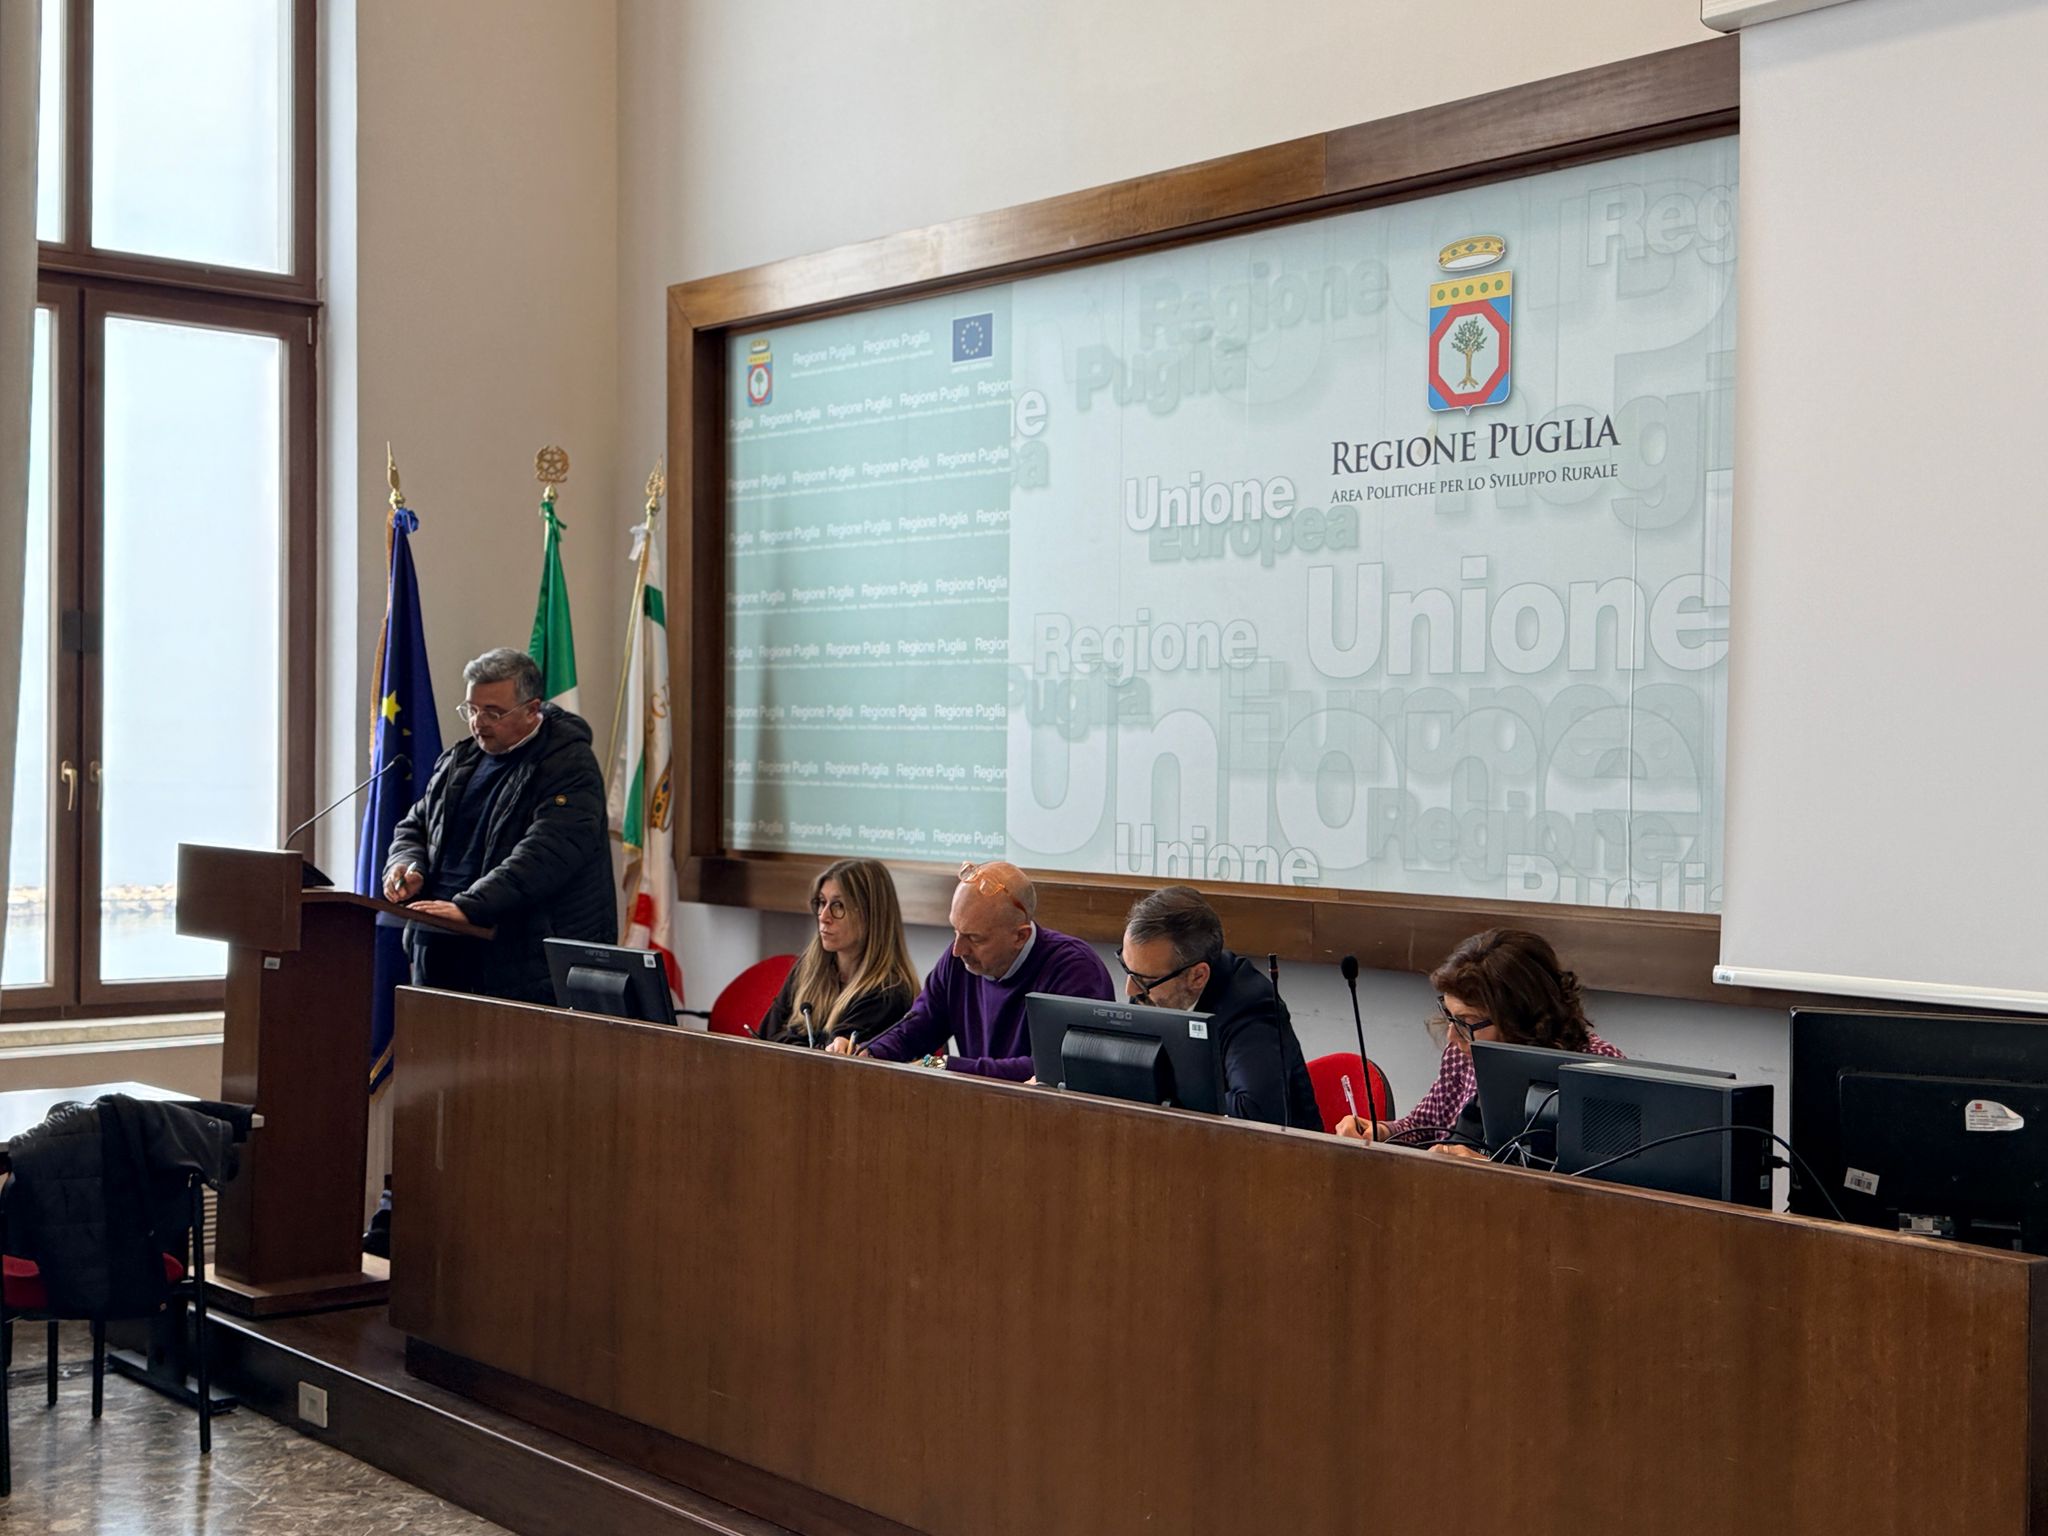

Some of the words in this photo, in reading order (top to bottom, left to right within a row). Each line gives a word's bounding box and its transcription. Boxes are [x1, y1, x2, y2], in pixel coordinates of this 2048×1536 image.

[793, 350, 827, 368] Regione
[829, 344, 855, 361] Puglia
[863, 336, 899, 354] Regione
[902, 330, 930, 348] Puglia
[796, 407, 820, 424] Puglia
[828, 402, 862, 419] Regione
[865, 397, 892, 413] Puglia
[900, 391, 937, 408] Regione
[940, 384, 969, 403] Puglia
[1331, 431, 1477, 475] REGIONE
[1488, 414, 1621, 459] PUGLIA
[792, 469, 826, 485] Regione
[829, 465, 854, 481] Puglia
[862, 460, 898, 478] Regione
[901, 455, 929, 472] Puglia
[937, 450, 975, 468] Regione
[978, 446, 1009, 463] Puglia
[1331, 487, 1363, 503] AREA
[1367, 481, 1436, 500] POLITICHE
[1440, 478, 1464, 493] PER
[1467, 475, 1486, 490] LO
[1489, 468, 1557, 489] SVILUPPO
[1562, 463, 1618, 482] RURALE
[1125, 471, 1296, 532] Unione
[794, 526, 820, 542] Puglia
[827, 522, 861, 540] Regione
[864, 520, 891, 536] Puglia
[899, 515, 936, 533] Regione
[939, 511, 968, 528] Puglia
[792, 588, 826, 605] Regione
[828, 586, 854, 602] Puglia
[862, 584, 898, 600] Regione
[900, 581, 928, 598] Puglia
[936, 578, 974, 596] Regione
[978, 576, 1008, 594] Puglia
[1306, 556, 1730, 679] Unione
[794, 644, 820, 660] Puglia
[826, 642, 860, 659] Regione
[863, 641, 890, 658] Puglia
[898, 640, 935, 656] Regione
[938, 638, 967, 655] Puglia
[1034, 608, 1258, 686] Regione
[792, 705, 825, 720] Regione
[828, 705, 852, 720] Puglia
[860, 704, 896, 720] Regione
[899, 704, 926, 721] Puglia
[935, 704, 973, 720] Regione
[976, 704, 1006, 721] Puglia
[793, 760, 818, 776] Puglia
[825, 761, 859, 778] Regione
[862, 762, 889, 778] Puglia
[897, 763, 934, 780] Regione
[937, 764, 965, 781] Puglia
[790, 822, 823, 838] Regione
[826, 823, 852, 840] Puglia
[859, 825, 894, 842] Regione
[897, 827, 925, 844] Puglia
[933, 829, 971, 846] Regione
[974, 831, 1004, 848] Puglia
[1114, 822, 1320, 887] Unione
